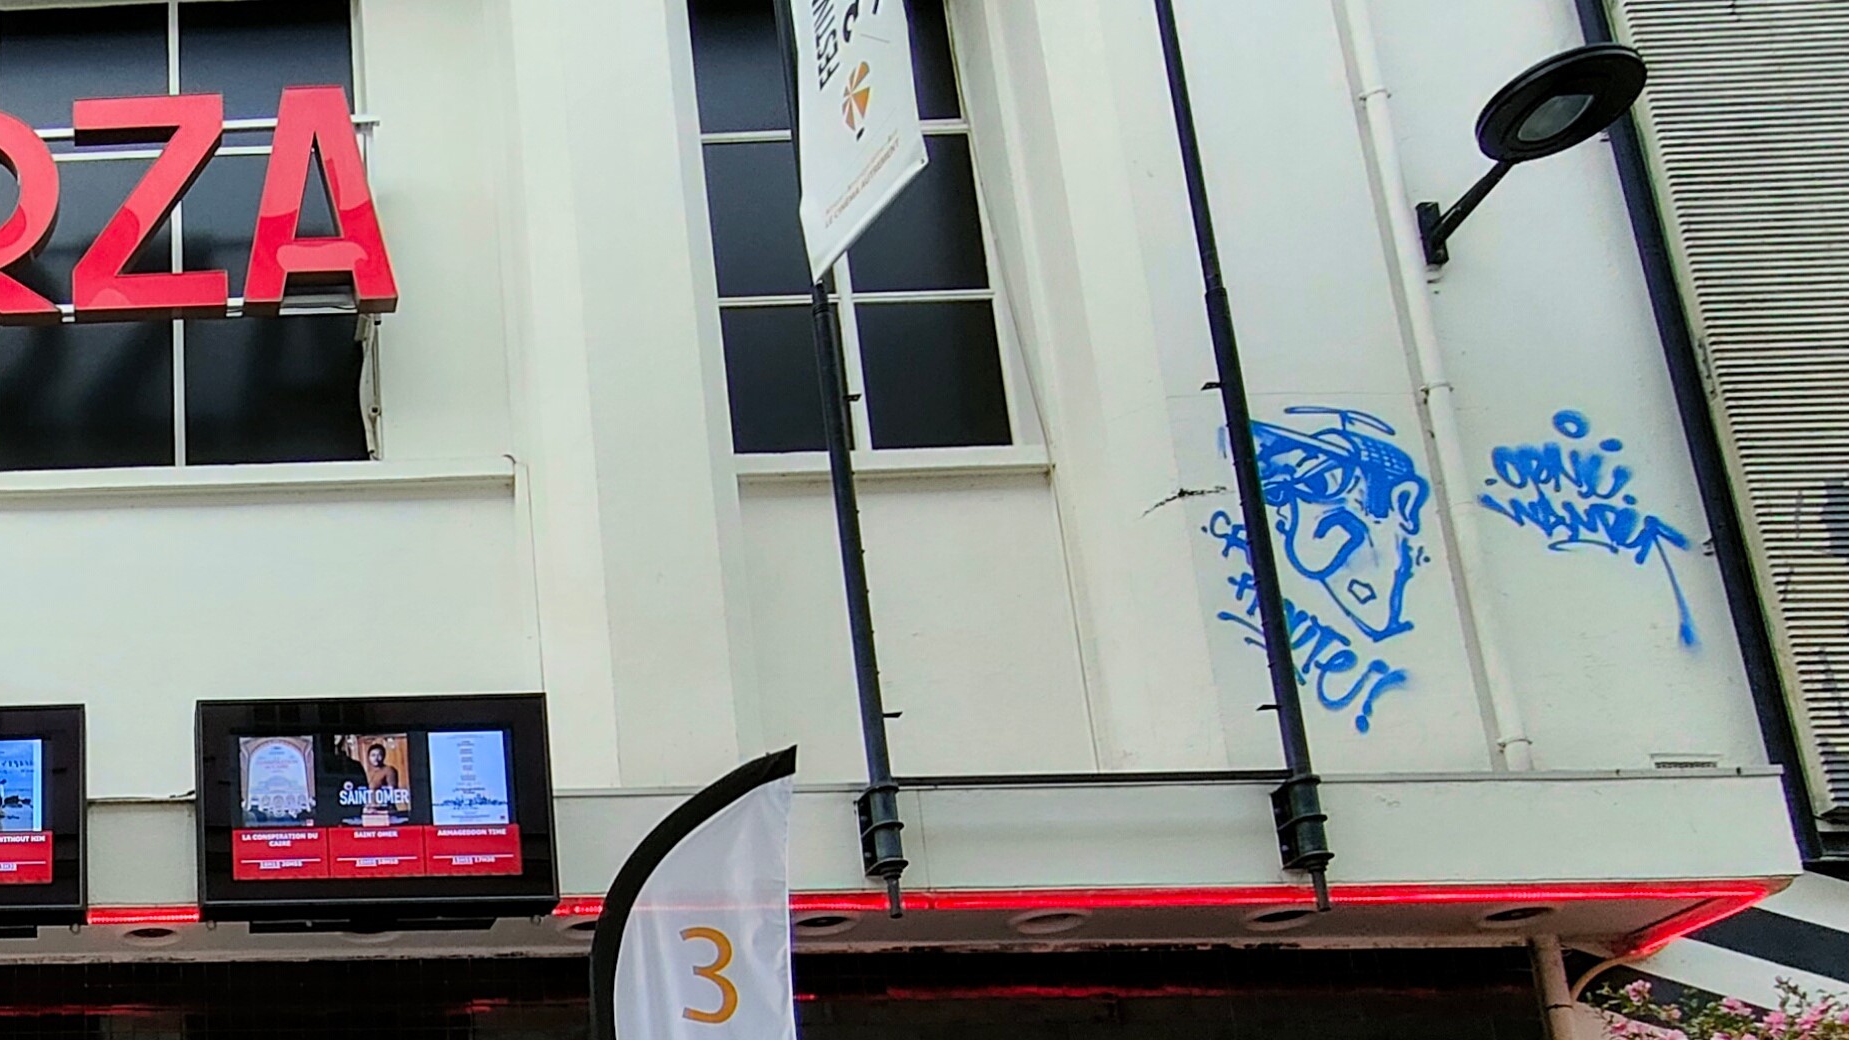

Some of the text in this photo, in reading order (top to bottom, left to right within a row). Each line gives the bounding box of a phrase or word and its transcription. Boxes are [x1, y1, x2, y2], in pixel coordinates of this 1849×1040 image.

[340, 787, 410, 806] SAINT OMER
[252, 832, 306, 840] CONSPIRATION
[308, 832, 318, 840] DU
[377, 830, 398, 838] OMER
[488, 828, 506, 836] TIME
[269, 839, 291, 847] CAIRE
[679, 926, 738, 1024] 3
